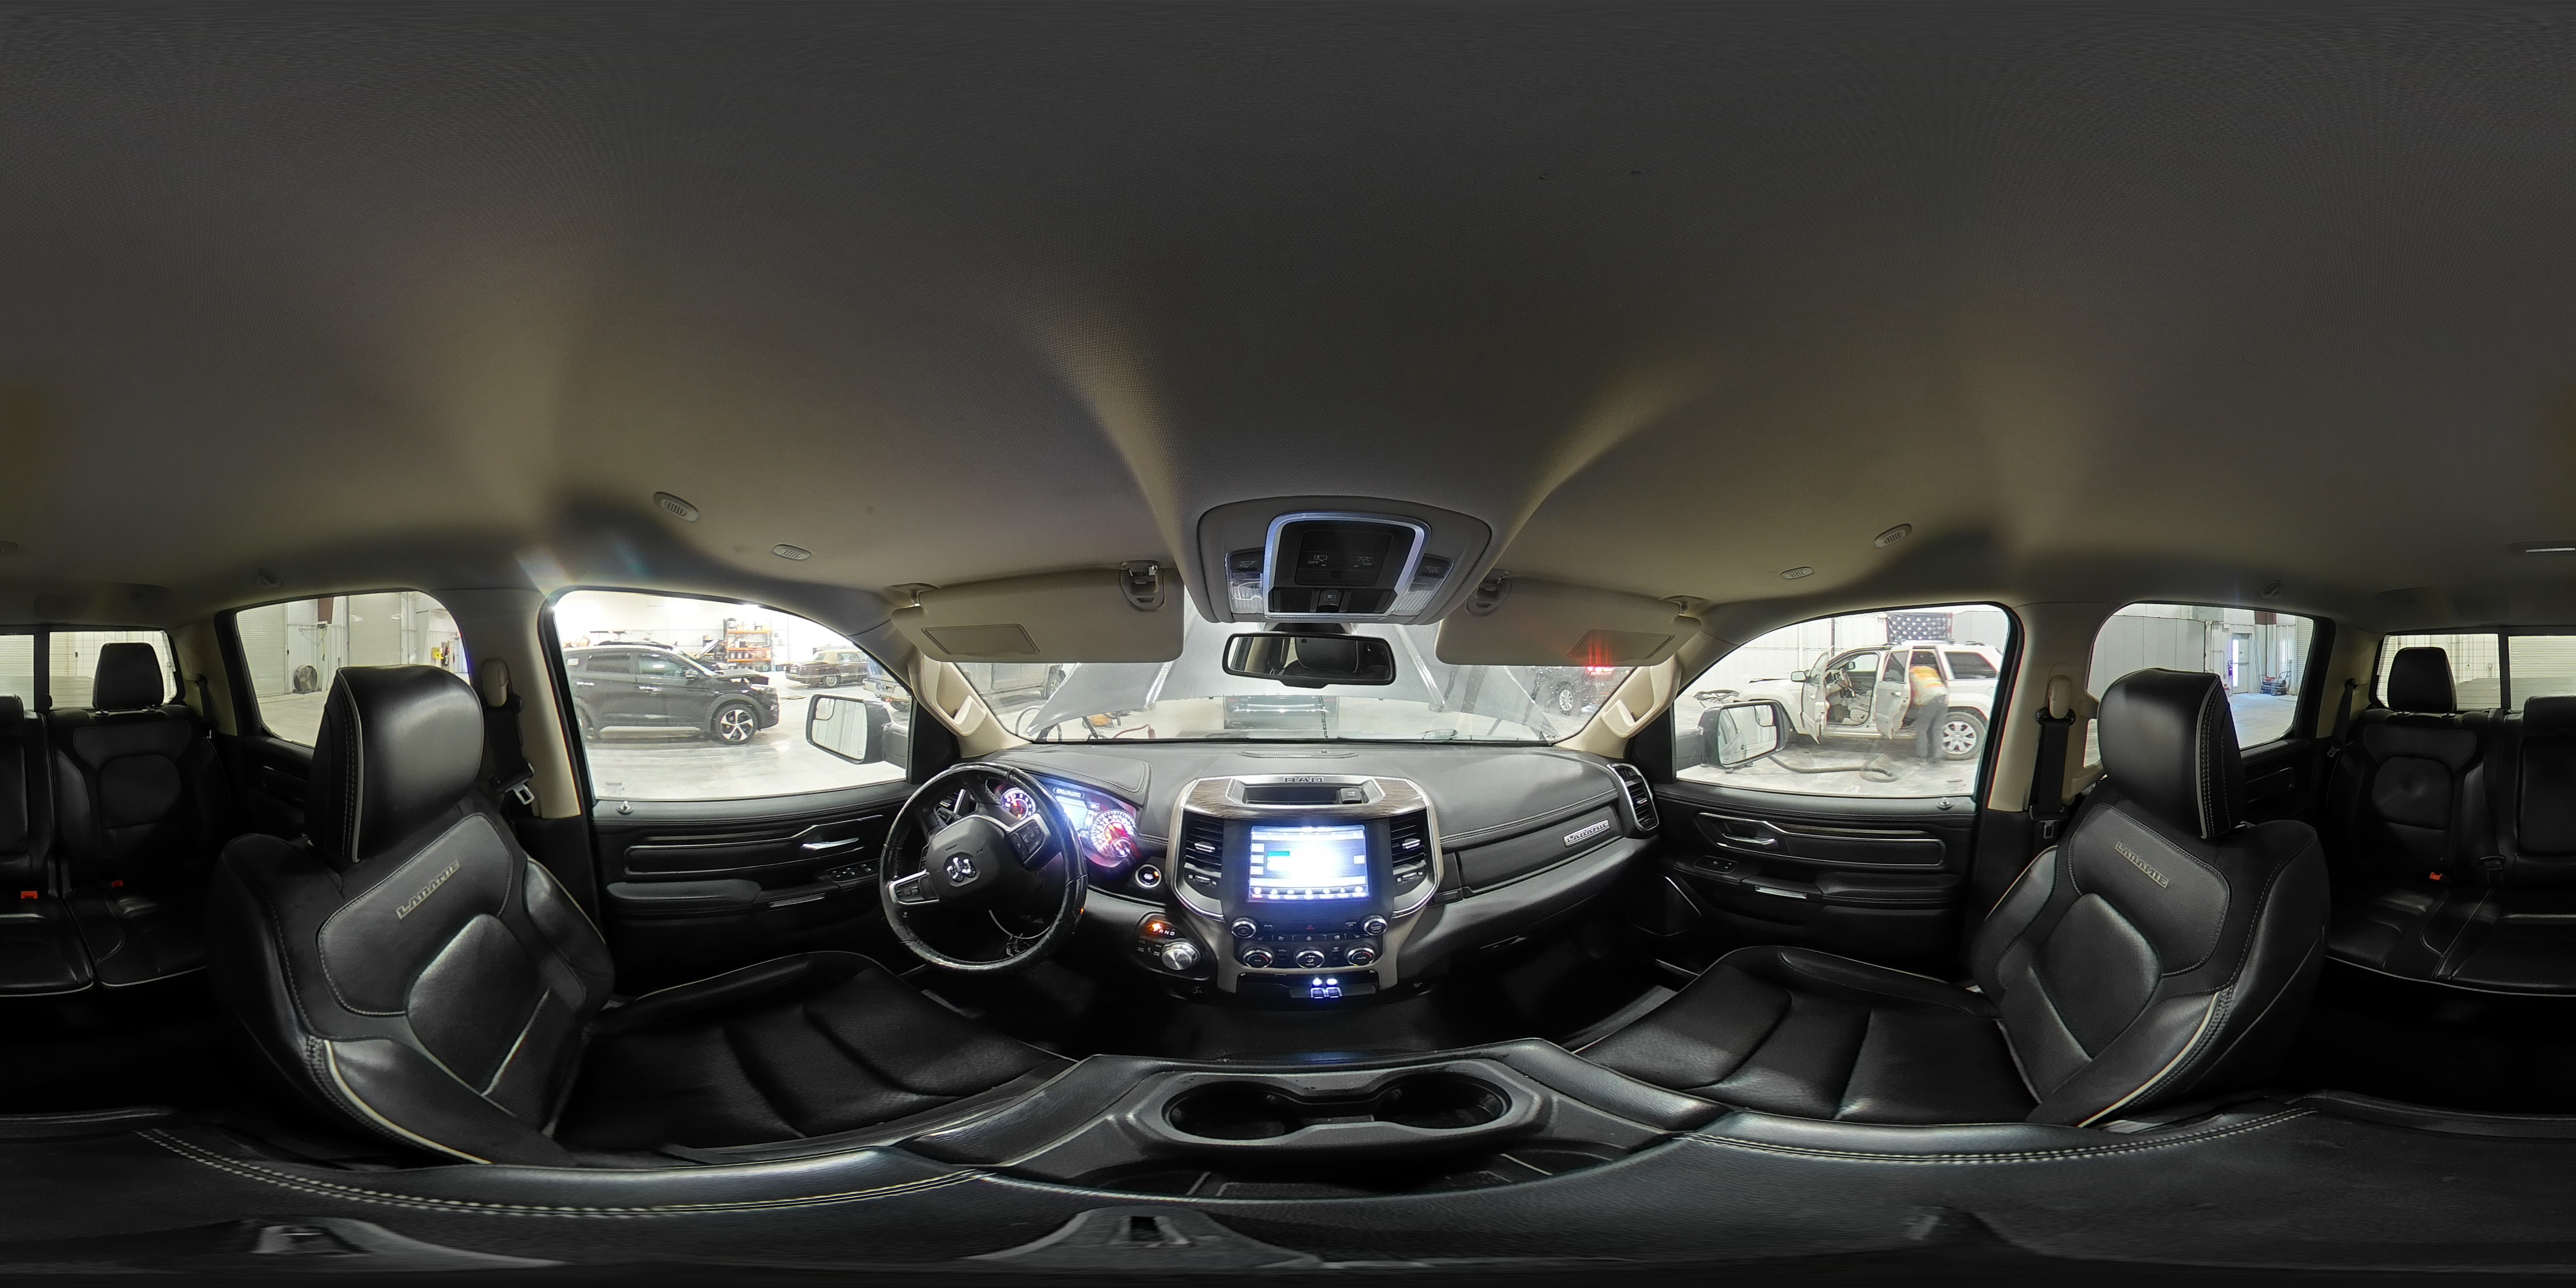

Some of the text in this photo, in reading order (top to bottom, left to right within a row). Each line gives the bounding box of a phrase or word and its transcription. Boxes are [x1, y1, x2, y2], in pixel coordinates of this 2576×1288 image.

[1566, 822, 1609, 843] LARAMIE
[2115, 841, 2169, 888] LARAMIE
[396, 859, 461, 919] LARAMIE
